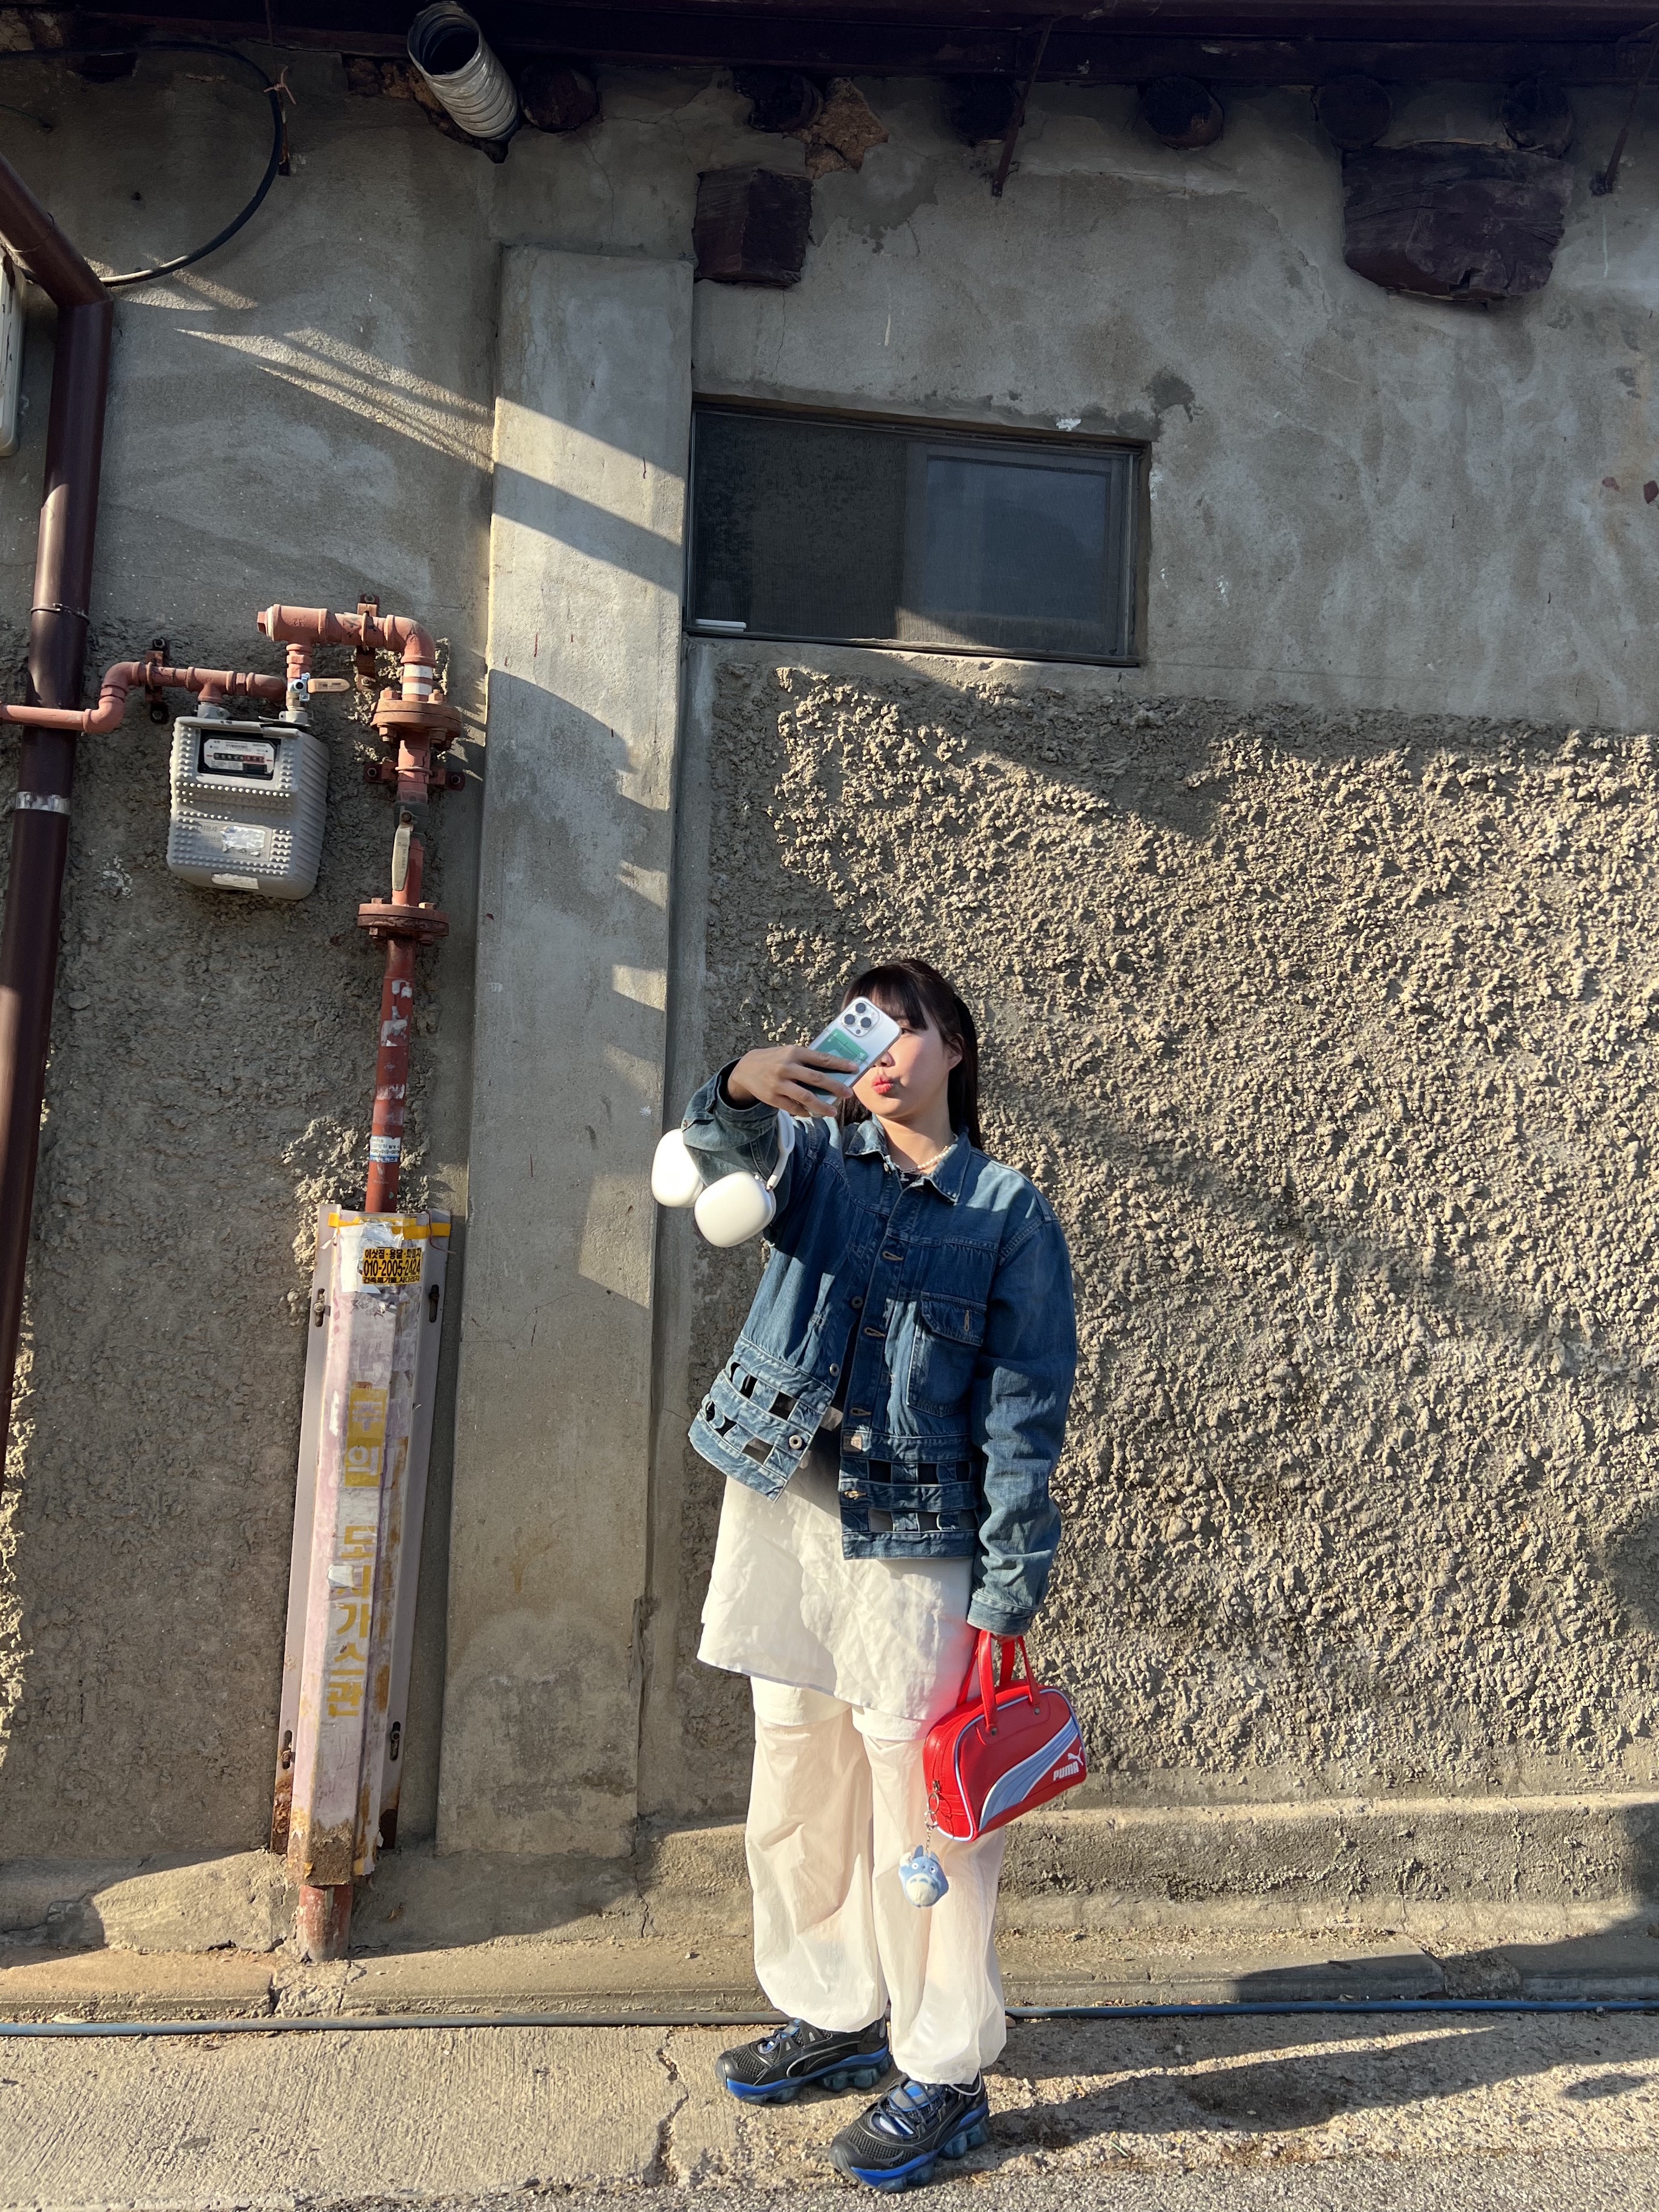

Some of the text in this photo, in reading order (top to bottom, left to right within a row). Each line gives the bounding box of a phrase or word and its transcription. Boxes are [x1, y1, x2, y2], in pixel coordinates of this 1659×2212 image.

[364, 1259, 420, 1276] 010-2005-2424
[348, 1401, 383, 1475] 주의
[1053, 1761, 1079, 1782] PUMA
